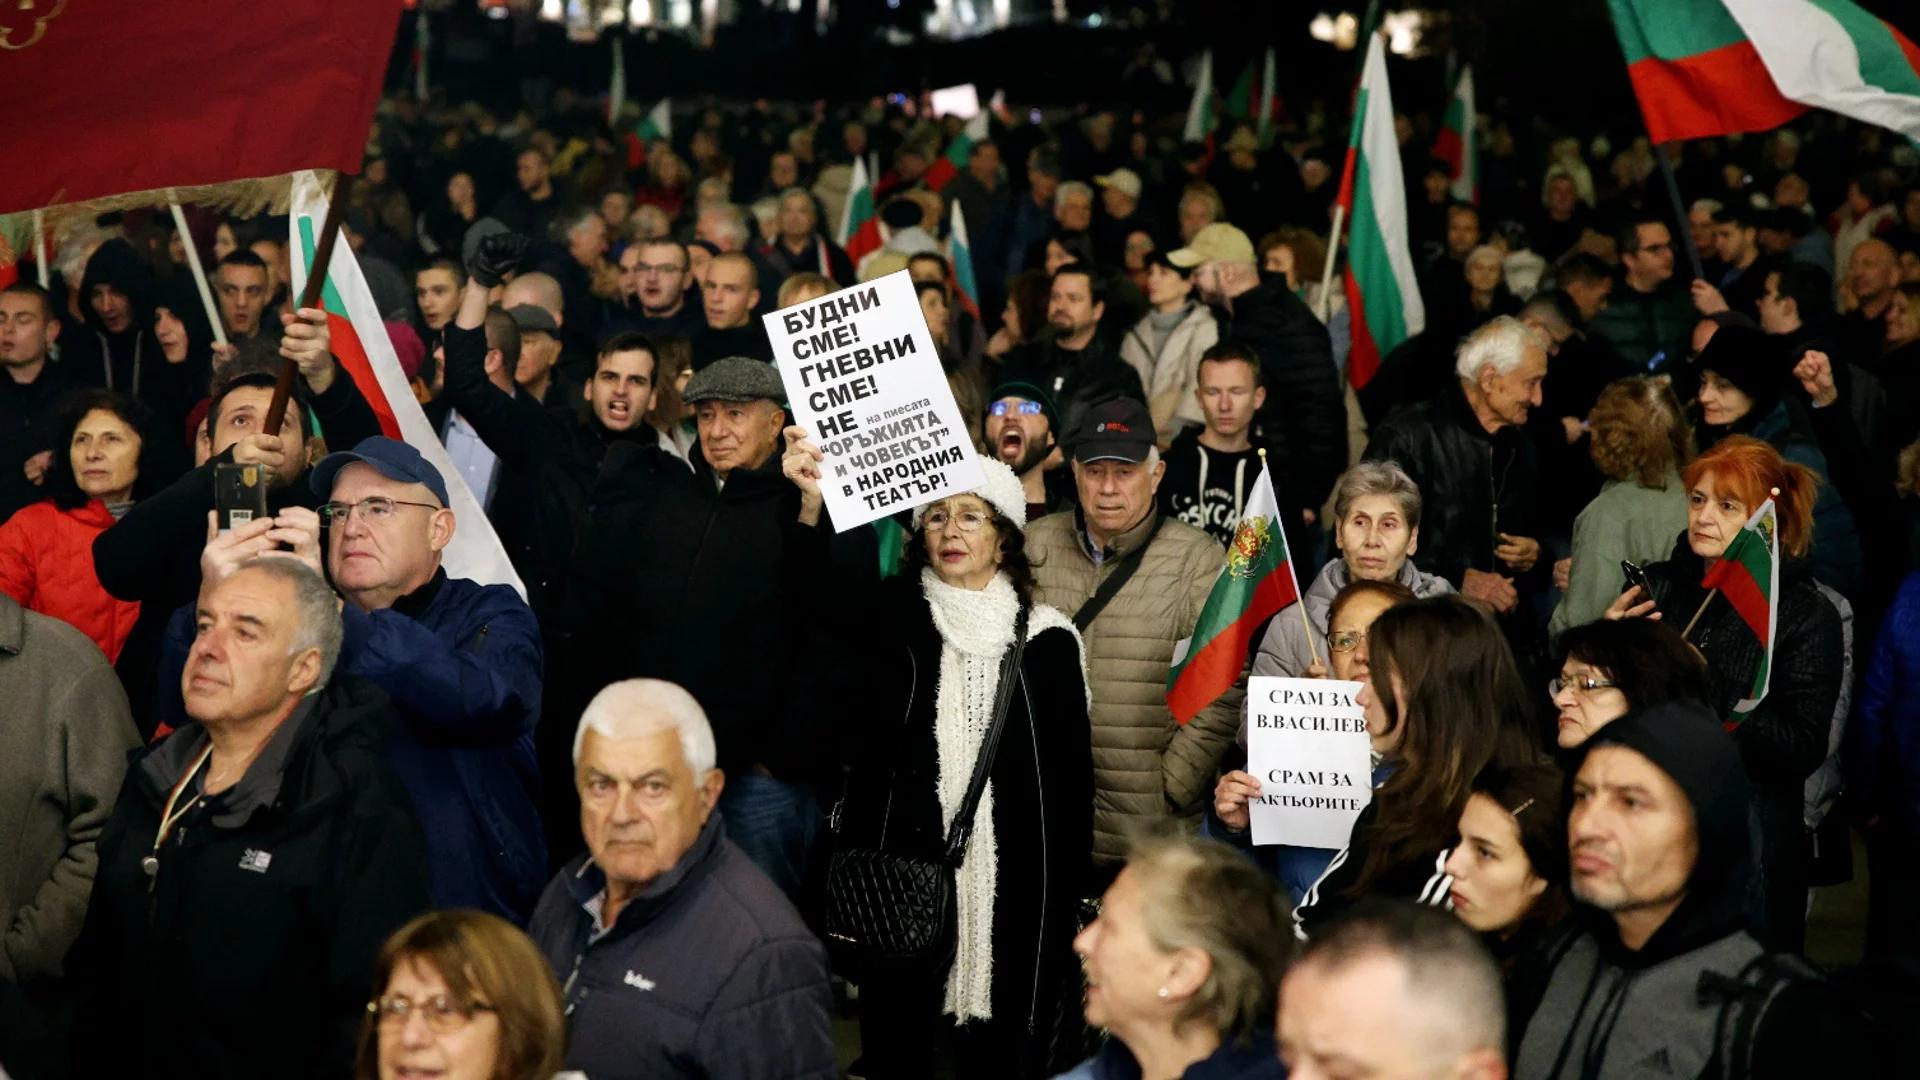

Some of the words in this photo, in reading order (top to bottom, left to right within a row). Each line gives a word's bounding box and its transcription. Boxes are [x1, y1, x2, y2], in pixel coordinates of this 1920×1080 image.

[783, 287, 881, 335] БУДНИ
[792, 322, 861, 360] СМЕ!
[799, 334, 916, 387] ГНЕВНИ
[809, 375, 879, 412] СМЕ!
[816, 410, 858, 439] НЕ
[866, 413, 881, 425] на
[883, 398, 931, 421] пиесата
[834, 464, 848, 478] и
[842, 483, 854, 497] в
[856, 445, 965, 492] НАРОДНИЯ
[863, 472, 948, 511] ТЕАТЪР!
[1269, 689, 1324, 706] СРАМ
[1329, 692, 1352, 707] ЗА
[1257, 714, 1365, 733] В.ВАСИЛЕВ
[1268, 769, 1324, 786] СРАМ
[1329, 772, 1352, 787] ЗА
